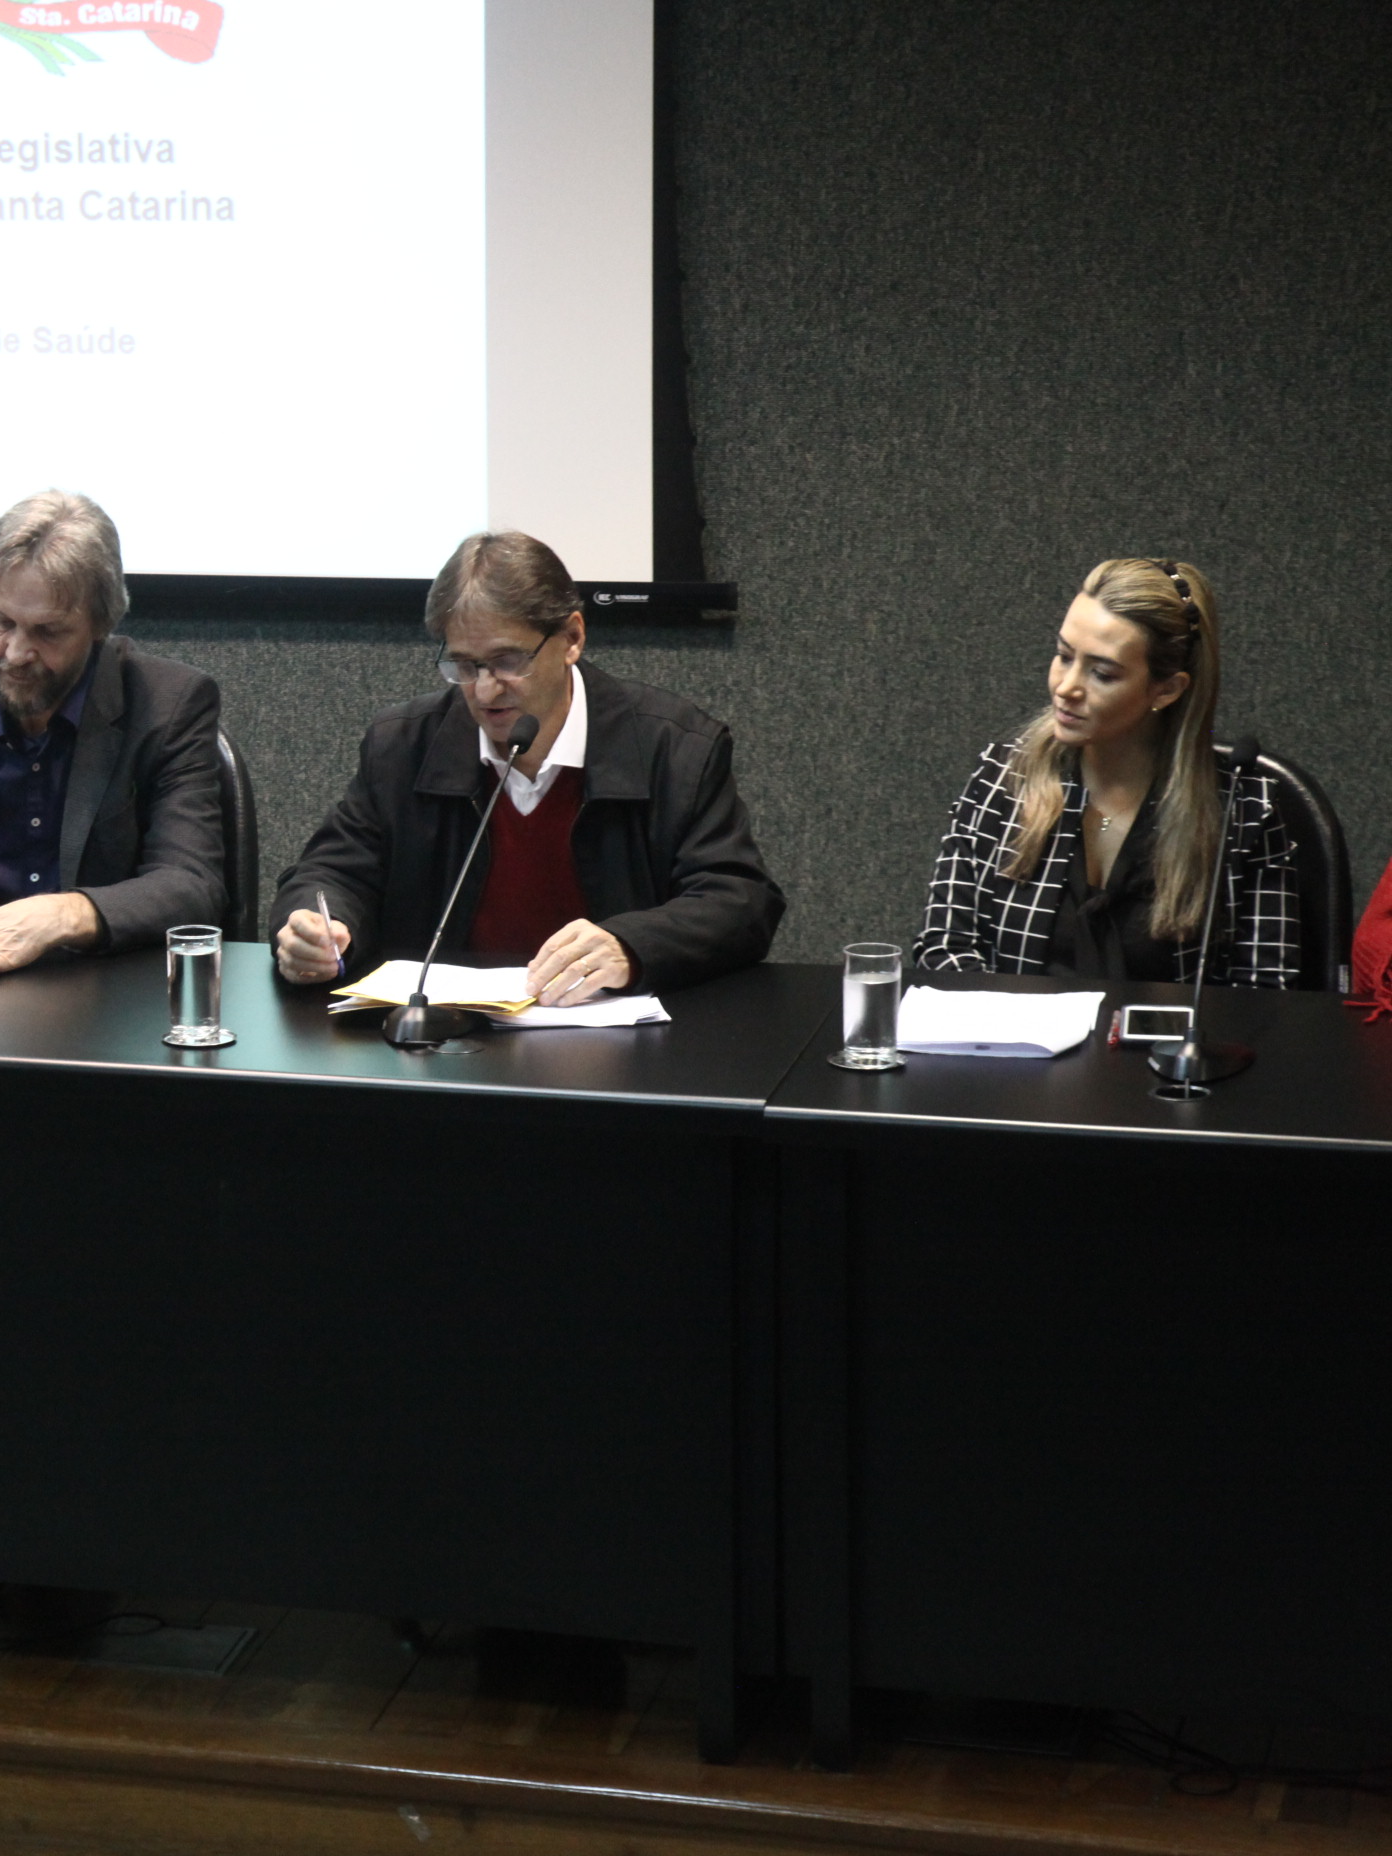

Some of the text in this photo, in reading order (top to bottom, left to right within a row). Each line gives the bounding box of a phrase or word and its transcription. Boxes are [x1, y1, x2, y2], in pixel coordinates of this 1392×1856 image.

[18, 7, 70, 26] Sta.
[78, 1, 199, 31] Catarina
[79, 190, 235, 222] Catarina
[33, 325, 136, 354] Saúde
